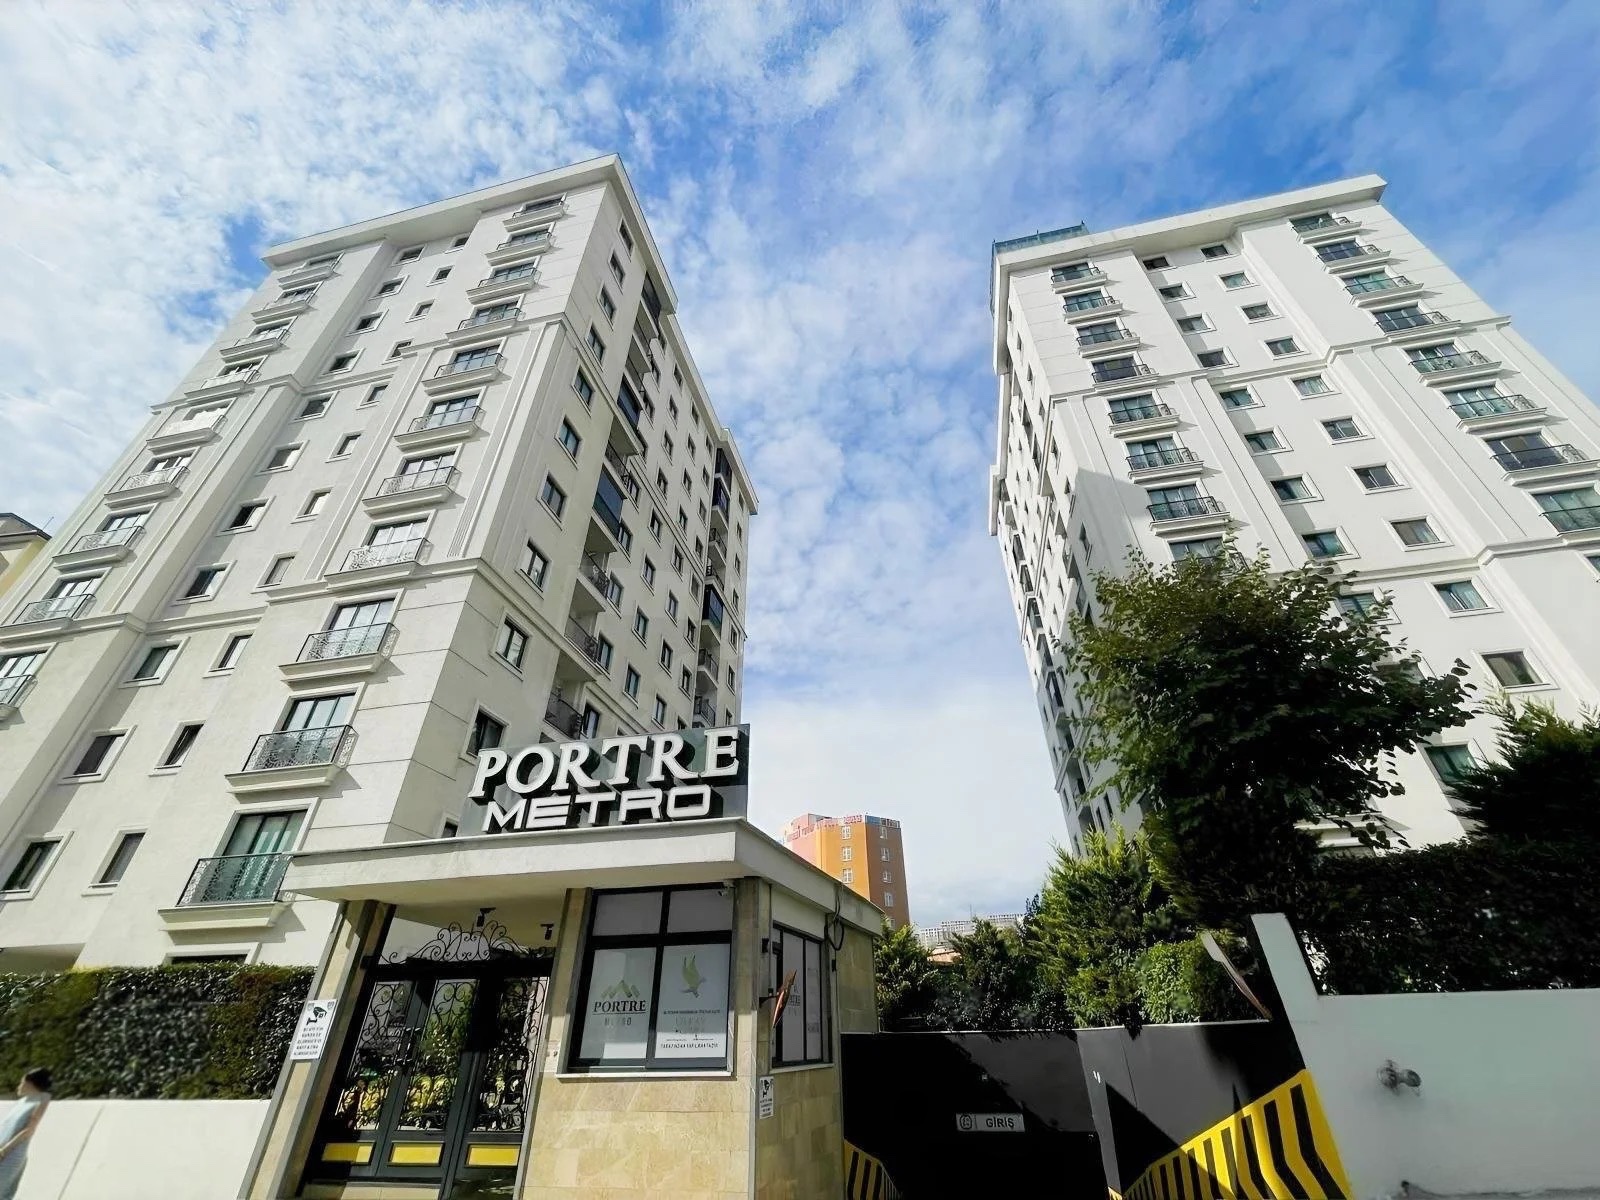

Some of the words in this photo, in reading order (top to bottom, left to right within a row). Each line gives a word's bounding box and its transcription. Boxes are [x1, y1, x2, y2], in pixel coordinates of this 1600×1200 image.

[468, 726, 740, 799] PORTRE
[482, 784, 712, 832] METRO
[593, 1000, 647, 1013] PORTRE
